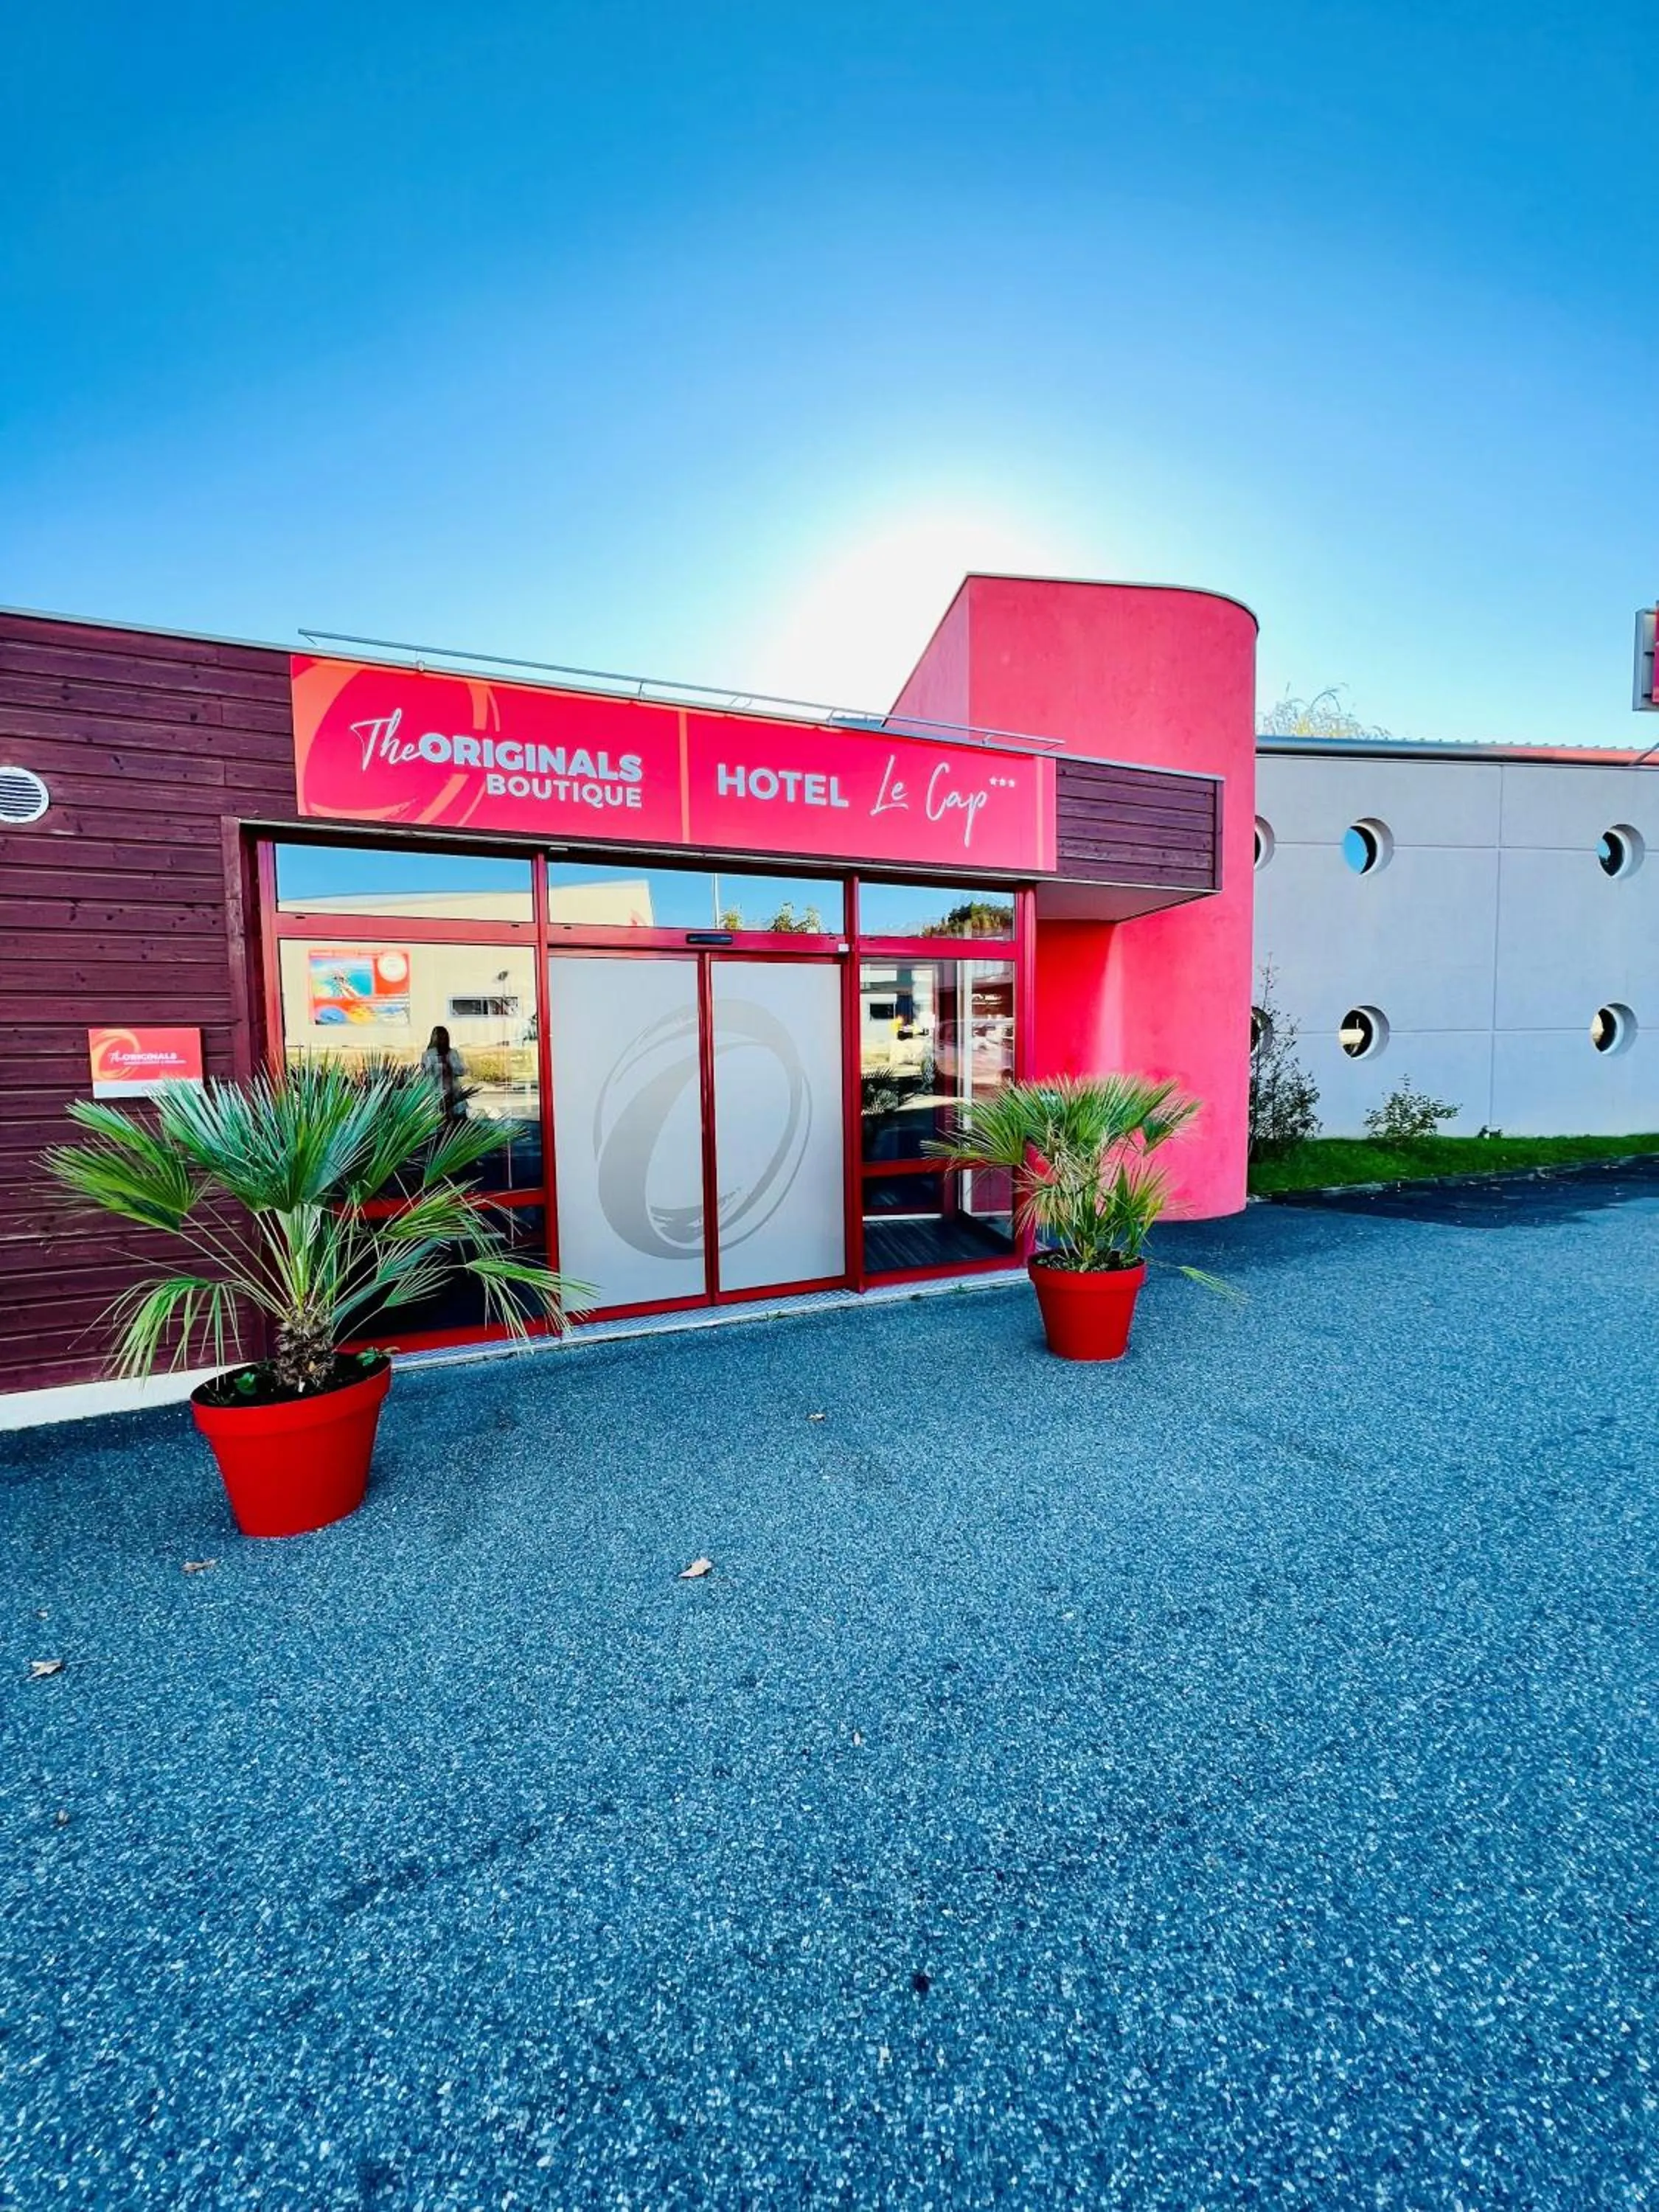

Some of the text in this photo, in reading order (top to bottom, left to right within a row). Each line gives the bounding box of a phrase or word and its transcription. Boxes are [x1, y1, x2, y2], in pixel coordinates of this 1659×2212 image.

[418, 733, 643, 782] ORIGINALS
[485, 773, 642, 808] BOUTIQUE
[717, 754, 990, 847] HOTEL Le Cap
